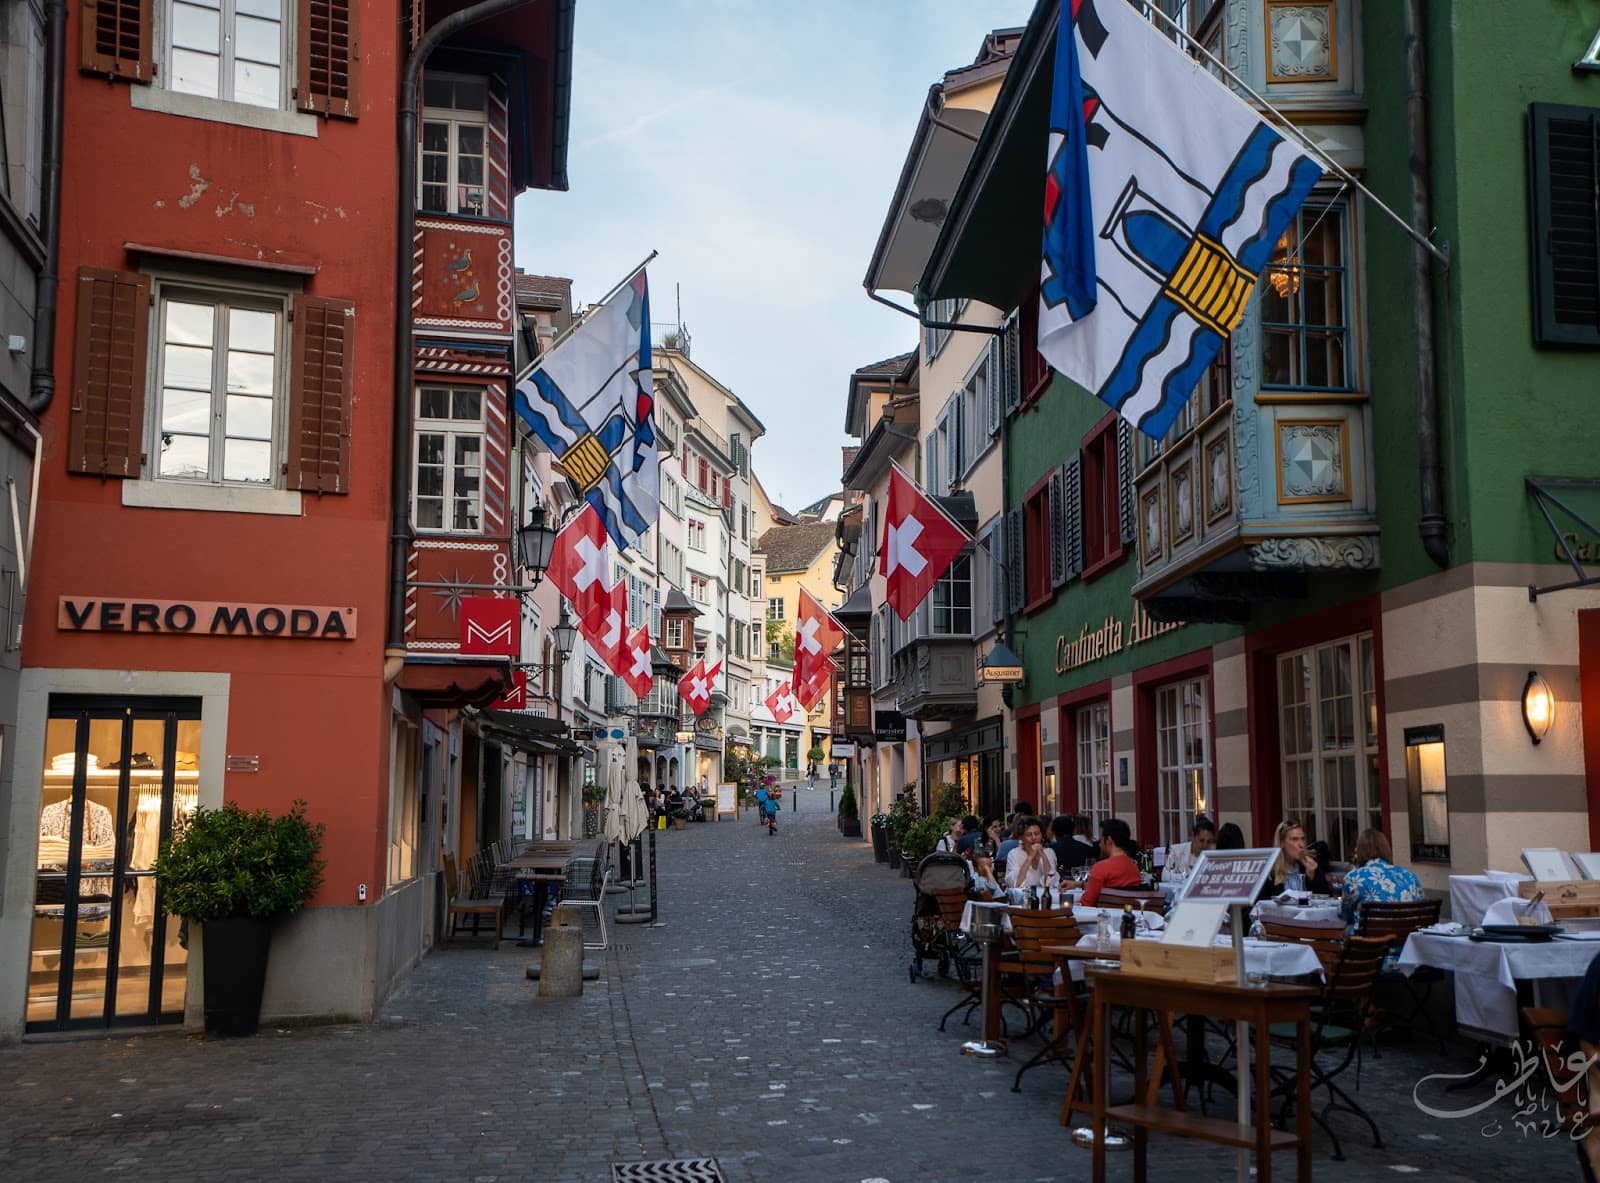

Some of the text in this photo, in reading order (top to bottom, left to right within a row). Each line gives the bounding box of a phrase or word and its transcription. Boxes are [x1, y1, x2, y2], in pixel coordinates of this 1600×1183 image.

[64, 600, 348, 638] VERO MODA
[1055, 615, 1123, 674] Cantinetta
[985, 668, 1021, 679] Augustiner
[1231, 860, 1266, 873] WAIT
[1194, 873, 1260, 884] TO BE SEATED
